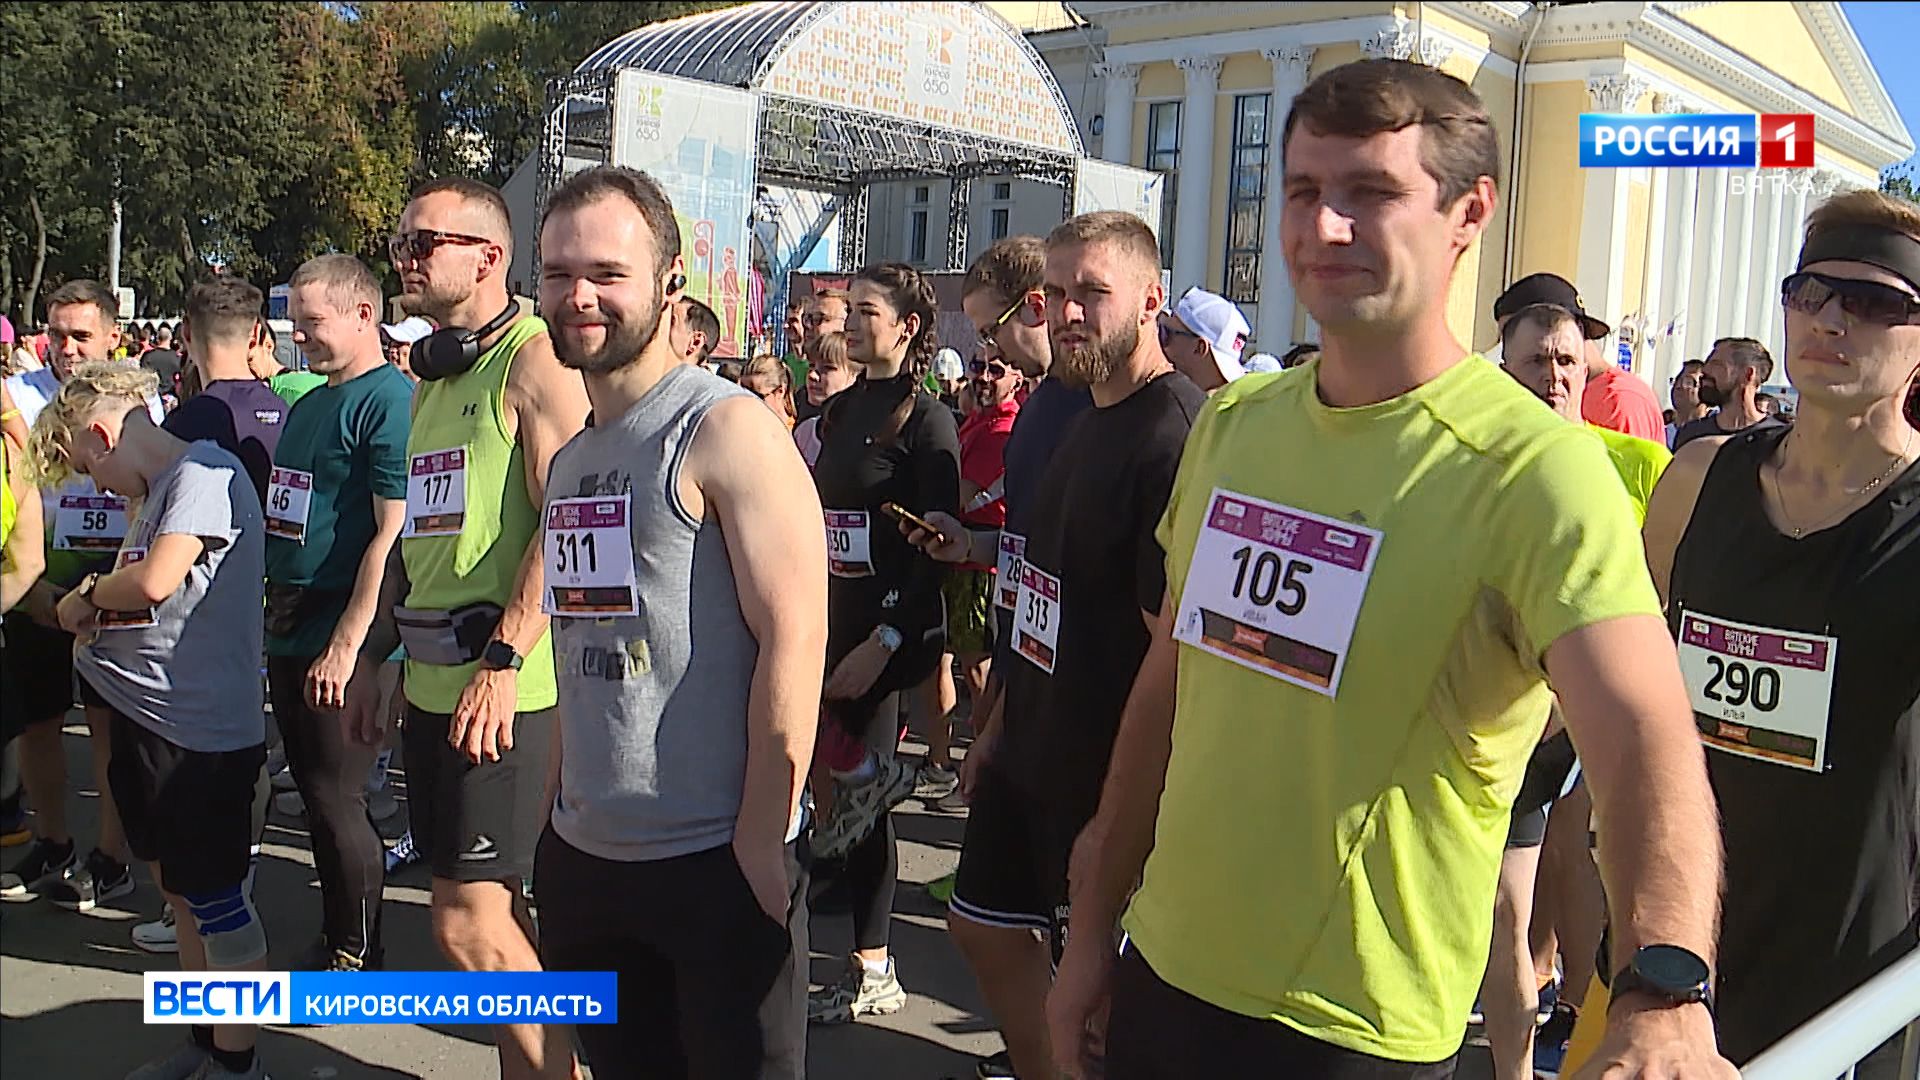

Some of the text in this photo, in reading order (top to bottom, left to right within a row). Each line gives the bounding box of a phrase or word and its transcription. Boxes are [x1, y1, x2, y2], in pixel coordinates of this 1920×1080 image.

[923, 79, 949, 96] 650
[635, 128, 660, 142] 650
[271, 487, 291, 511] 46
[423, 474, 452, 506] 177
[82, 511, 108, 530] 58
[556, 532, 596, 573] 311
[1232, 545, 1313, 616] 105
[1025, 591, 1049, 631] 313
[1703, 655, 1781, 712] 290
